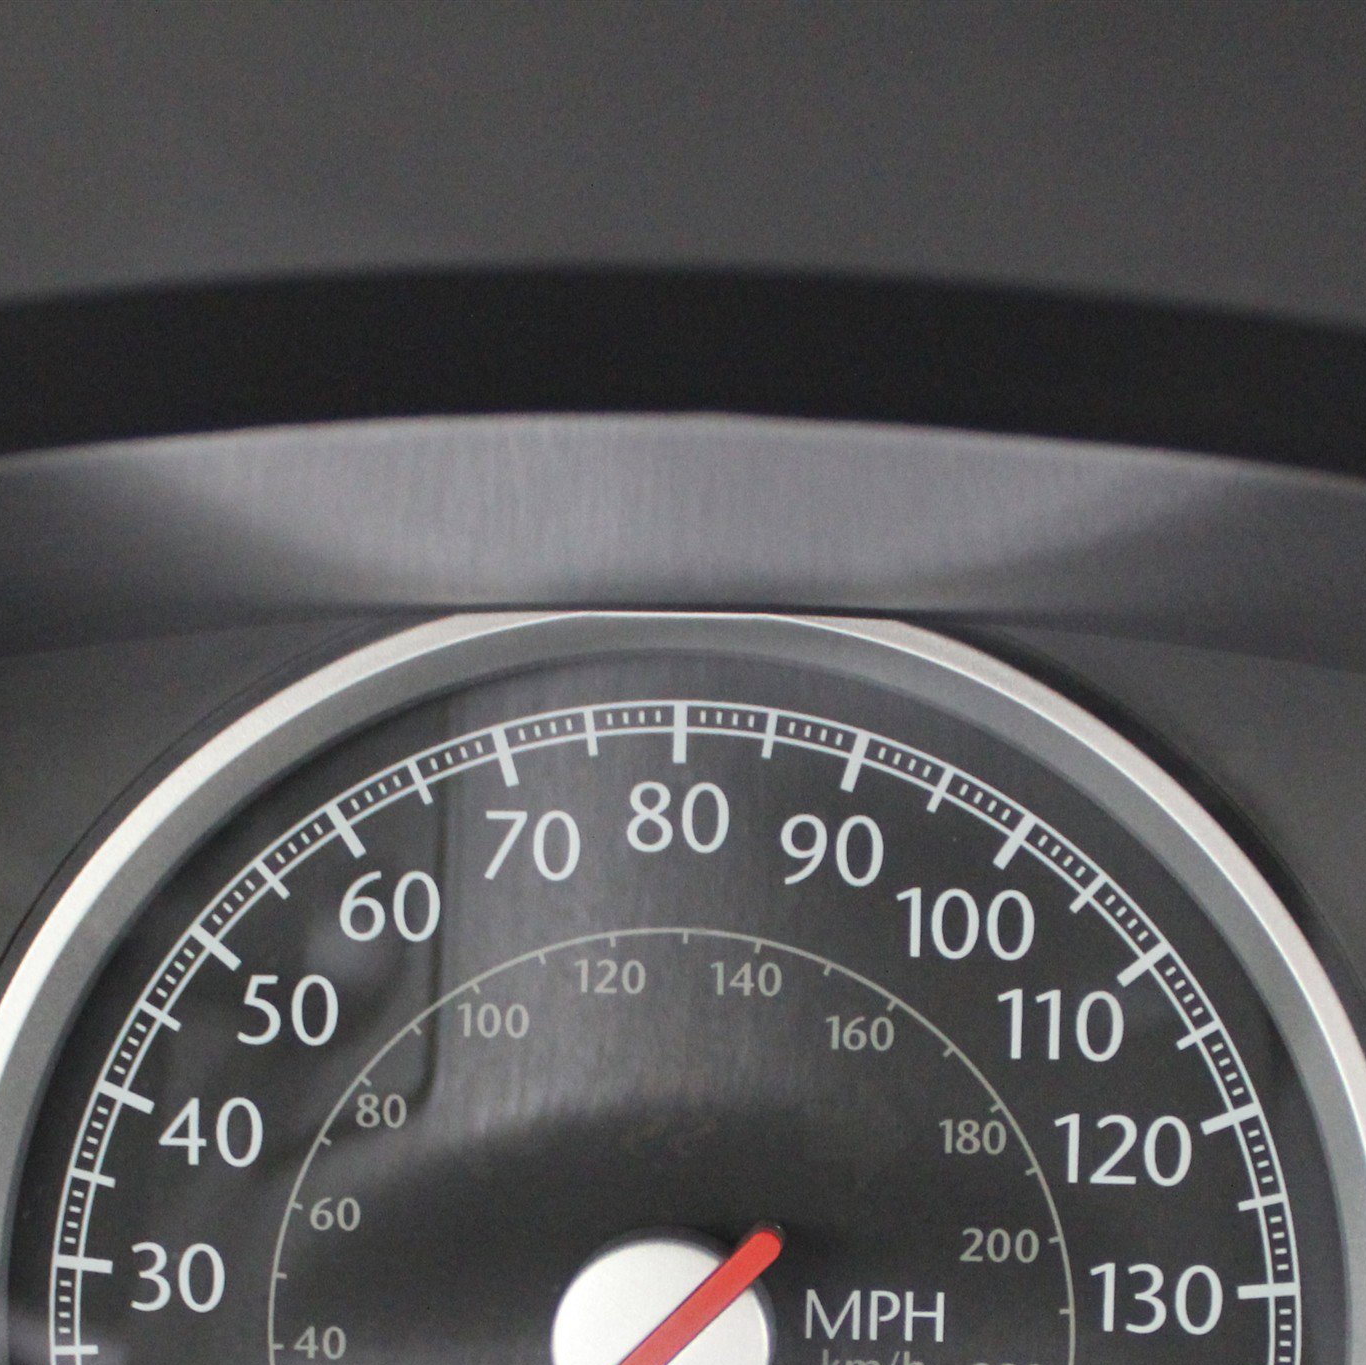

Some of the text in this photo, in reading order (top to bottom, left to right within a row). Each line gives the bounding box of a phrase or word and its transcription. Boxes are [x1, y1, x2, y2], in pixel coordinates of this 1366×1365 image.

[483, 810, 580, 880] 70
[626, 782, 728, 853] 80
[780, 814, 884, 886] 90
[339, 871, 440, 941] 60
[896, 887, 1035, 961] 100
[237, 974, 338, 1045] 50
[574, 959, 645, 994] 120
[710, 961, 782, 996] 140
[457, 1003, 529, 1039] 100
[826, 1016, 894, 1051] 160
[997, 988, 1123, 1061] 110
[158, 1097, 263, 1167] 40
[355, 1094, 406, 1128] 80
[939, 1119, 1006, 1155] 180
[1054, 1112, 1192, 1186] 120
[309, 1197, 360, 1231] 60
[960, 1228, 1039, 1263] 200
[131, 1242, 225, 1312] 30
[1090, 1262, 1223, 1335] 130
[294, 1326, 346, 1360] 40
[804, 1289, 945, 1342] MPH
